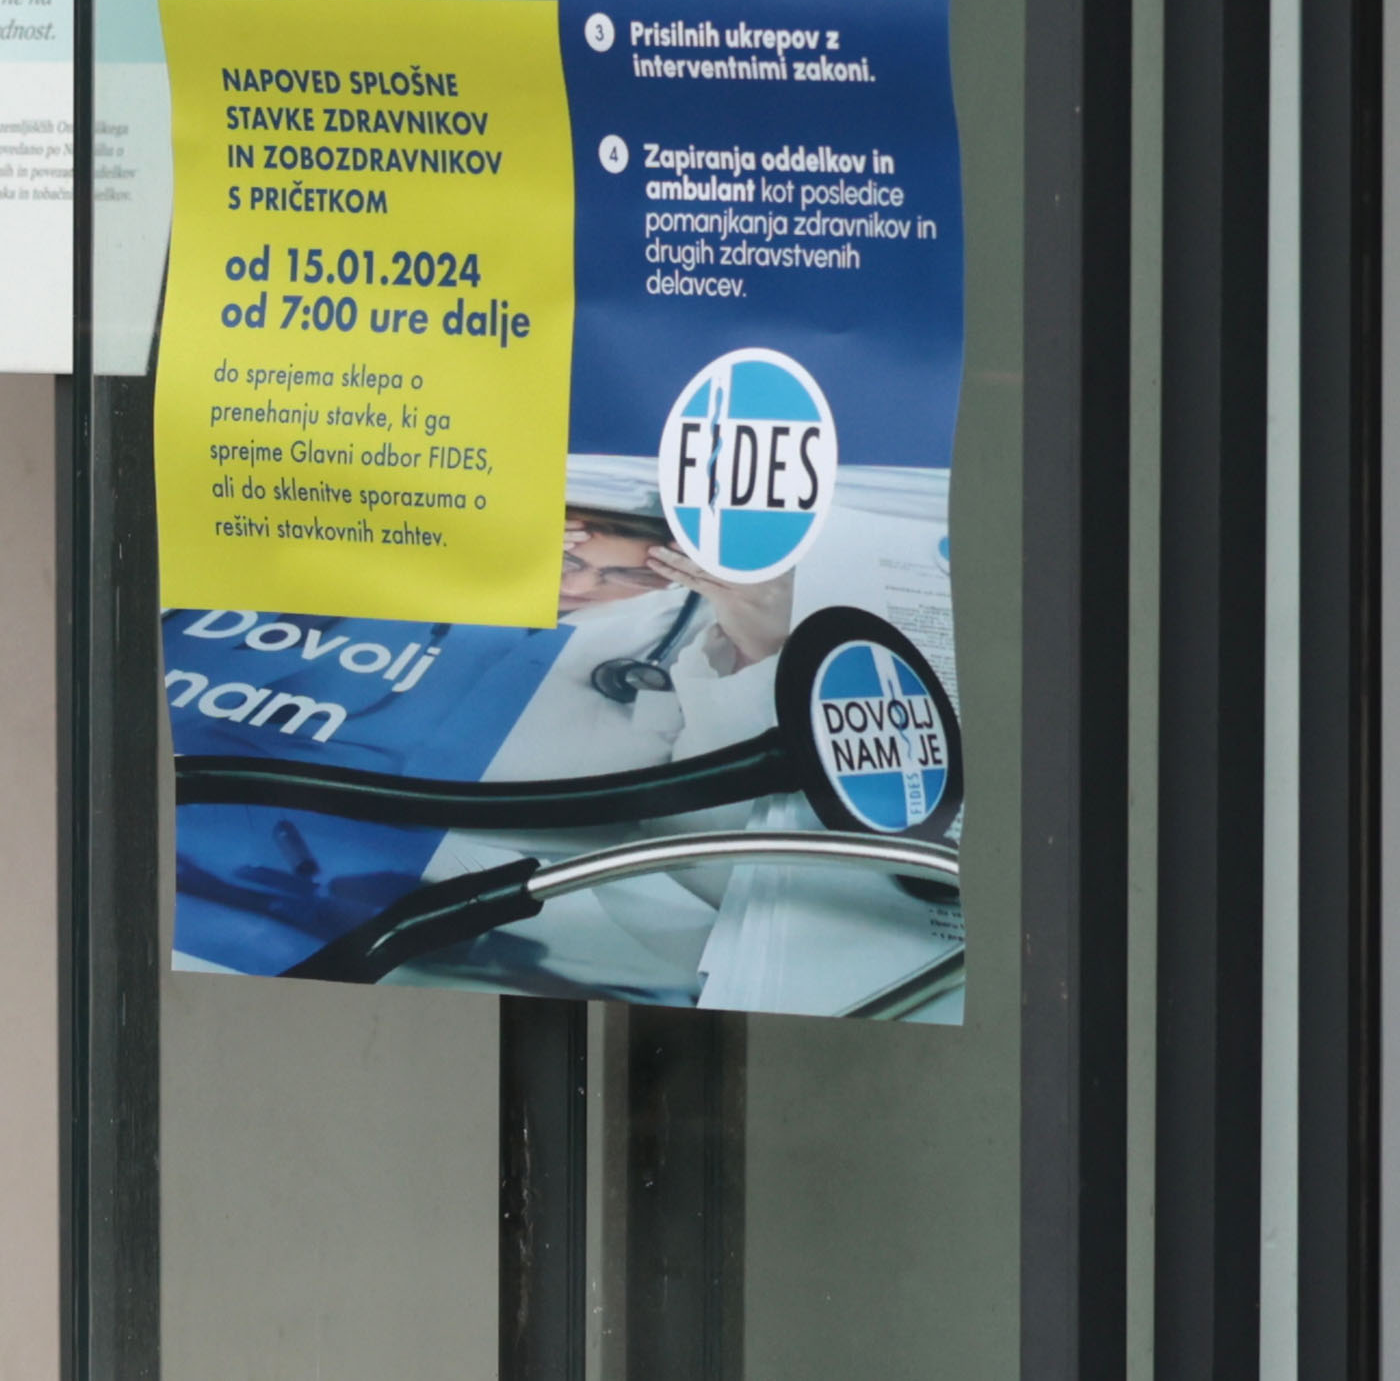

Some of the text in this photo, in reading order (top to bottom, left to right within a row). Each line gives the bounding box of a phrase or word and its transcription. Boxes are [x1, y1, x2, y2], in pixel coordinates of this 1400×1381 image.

[595, 24, 604, 41] 3
[631, 21, 839, 56] Prisilnih ukrepov z
[222, 65, 458, 97] NAPOVED SPLOŠNE
[632, 53, 875, 82] interventnimi zakoni.
[226, 106, 488, 136] STAVKE ZDRAVNIKOV
[227, 145, 502, 174] IN ZOBOZDRAVNIKOV
[609, 146, 619, 163] 4
[643, 143, 895, 178] Zapiranja oddelkov in
[228, 180, 388, 213] S PRIČETKOM
[646, 175, 904, 211] ambulant kot posledice
[646, 208, 936, 241] pomanjkanja zdravnikov in
[225, 244, 481, 288] od 15.01.2024
[646, 237, 860, 271] drugih zdravstvenih
[646, 269, 747, 297] delavcev.
[221, 291, 530, 348] od 7:00 ure dalje
[214, 358, 423, 395] do sprejema sklepa o
[210, 399, 450, 436] prenehanju stavke, ki ga
[210, 439, 493, 475] sprejme Glavni odbor FIDES,
[677, 422, 821, 511] FIDES
[212, 474, 487, 511] ali do sklenitve sporazuma o
[215, 514, 447, 547] rešitvi stavkovnih zahtev.
[183, 609, 441, 693] Dovolj
[164, 668, 347, 743] nam
[822, 697, 935, 735] DOVOLJ
[831, 733, 943, 772] NAM JE
[910, 772, 921, 816] FIDES
